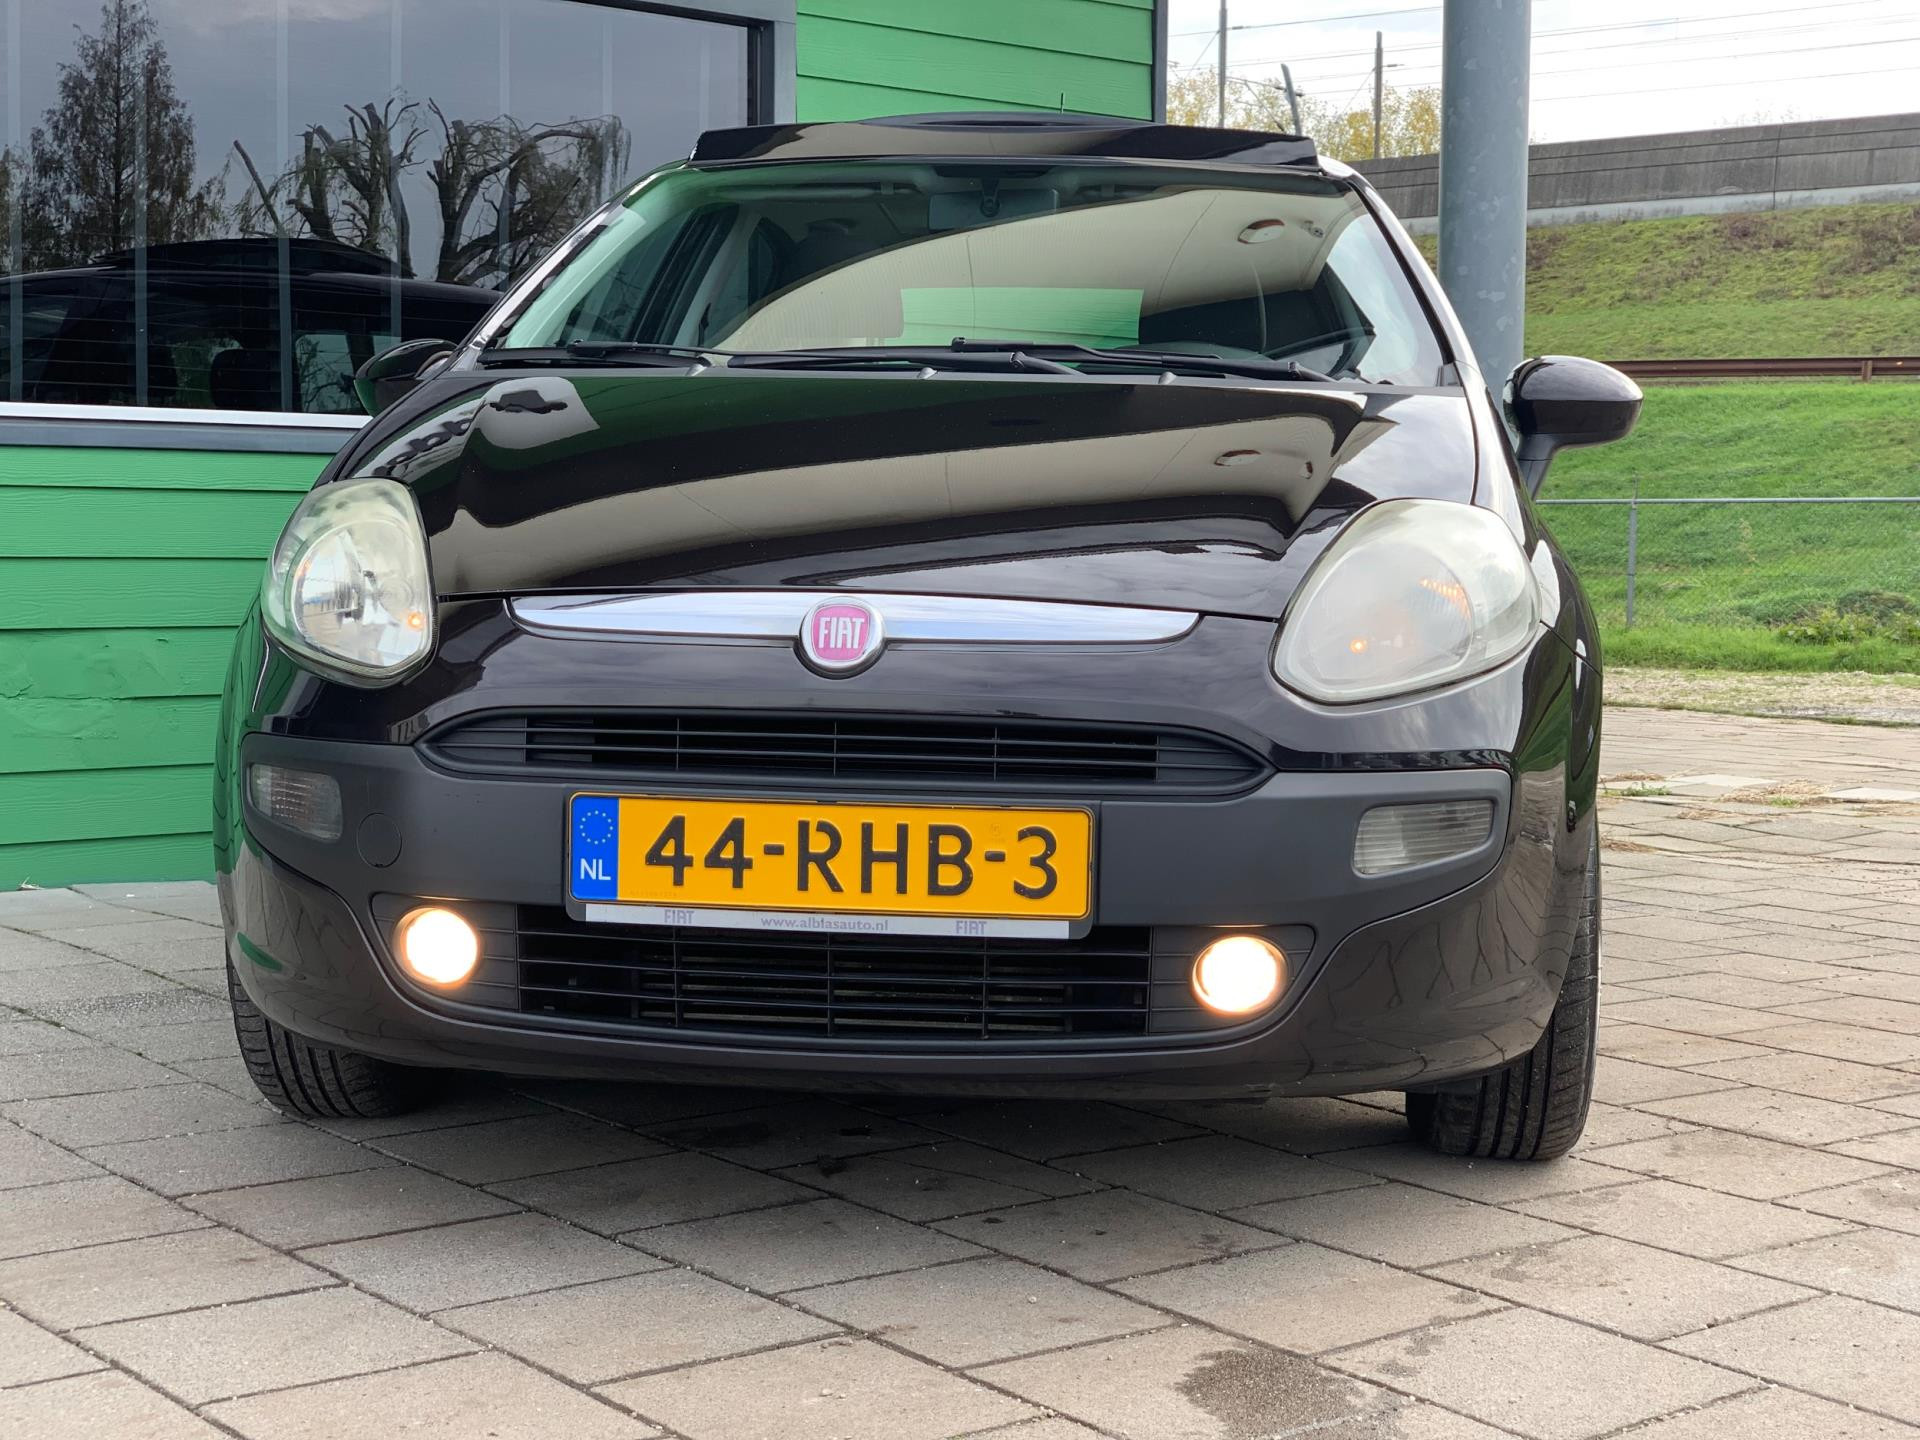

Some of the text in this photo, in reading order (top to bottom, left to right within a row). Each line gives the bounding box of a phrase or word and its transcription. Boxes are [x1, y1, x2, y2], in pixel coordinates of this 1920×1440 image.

[818, 616, 865, 649] FIAT
[645, 815, 1058, 899] 44-RHB-3
[580, 858, 611, 881] NL
[664, 908, 695, 925] FIAT
[760, 917, 889, 932] www.alblasauto.nl
[956, 920, 988, 936] FIAT
